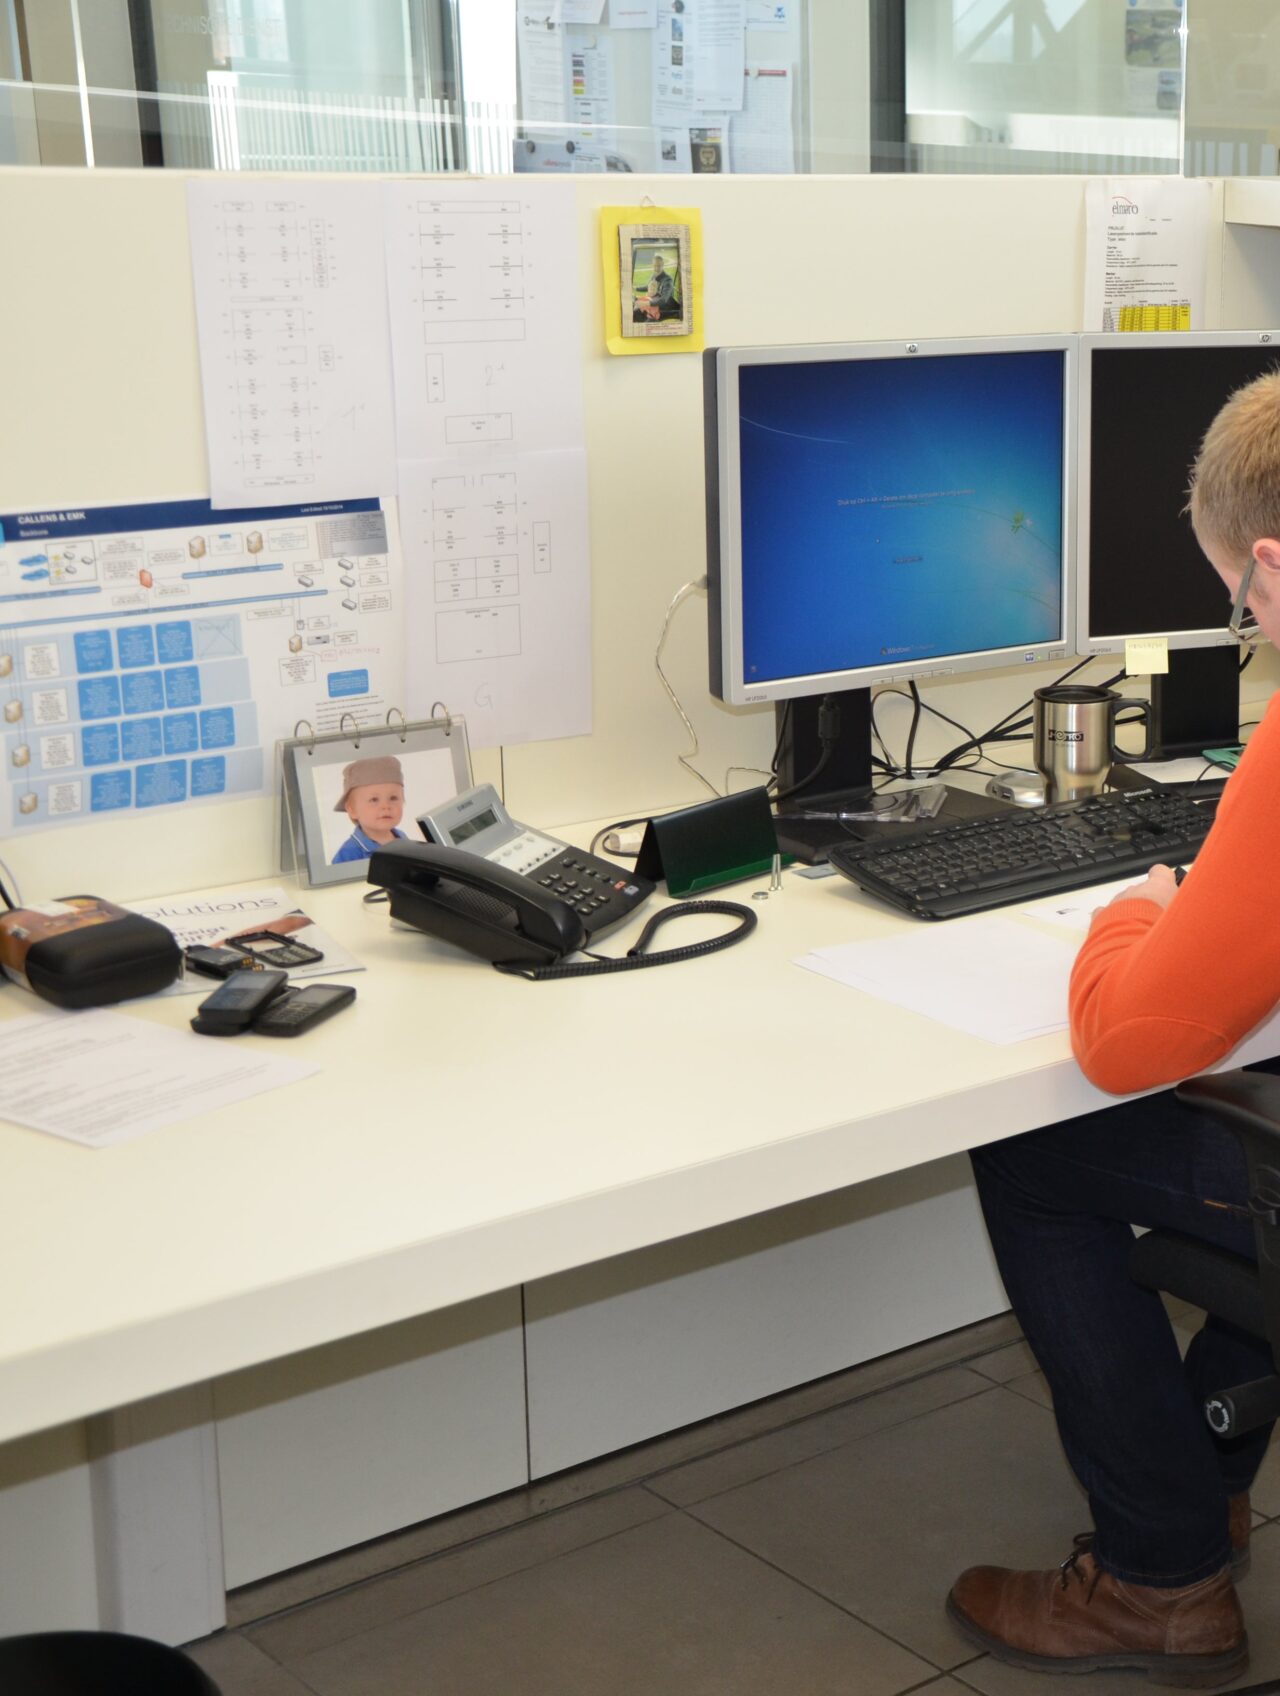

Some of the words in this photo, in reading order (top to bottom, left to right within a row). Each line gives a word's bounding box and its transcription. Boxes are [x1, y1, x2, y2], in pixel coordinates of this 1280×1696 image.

[1111, 201, 1139, 215] elmaro
[18, 514, 58, 525] CALLENS
[66, 510, 86, 521] EMK
[1124, 788, 1153, 798] Microsoft
[140, 897, 279, 920] olutions
